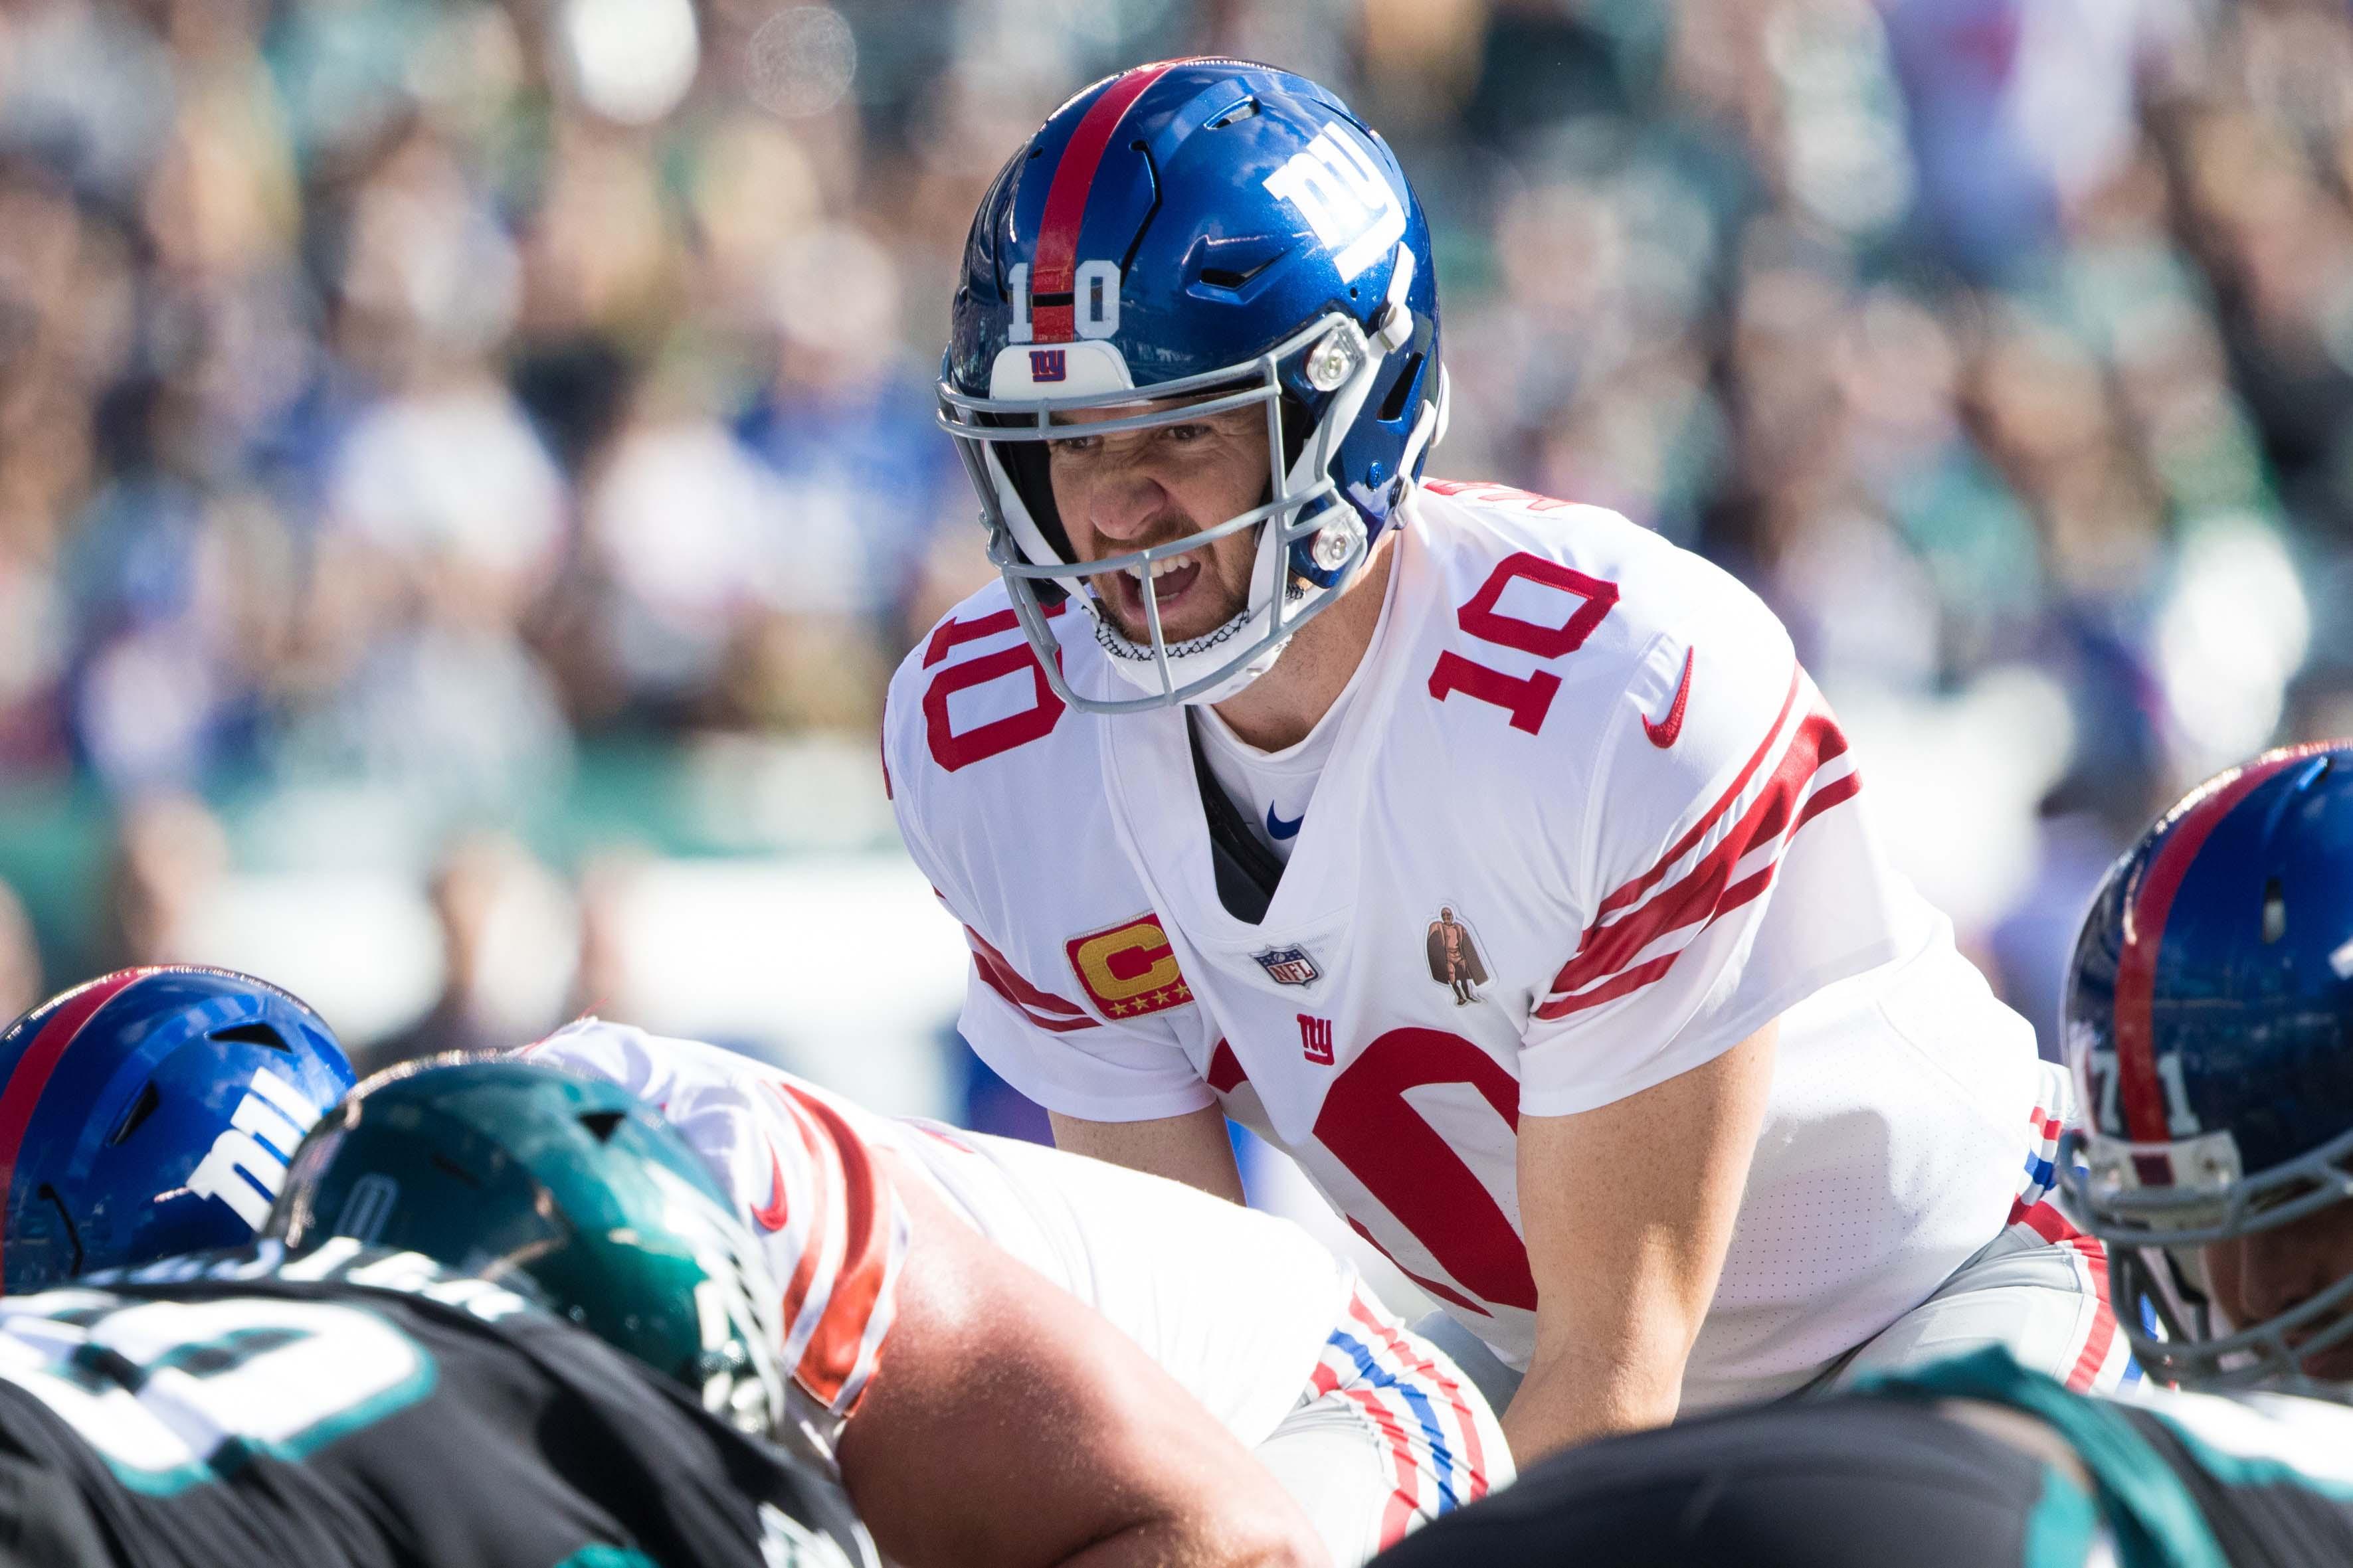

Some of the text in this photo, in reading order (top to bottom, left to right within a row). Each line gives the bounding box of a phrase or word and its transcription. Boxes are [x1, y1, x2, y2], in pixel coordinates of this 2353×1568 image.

[1008, 260, 1121, 343] 10
[1028, 349, 1067, 383] ny
[1428, 551, 1620, 737] 10
[921, 598, 1066, 774] 10
[1077, 923, 1180, 1002] C
[1269, 961, 1314, 982] NFL
[1296, 1013, 1335, 1067] ny
